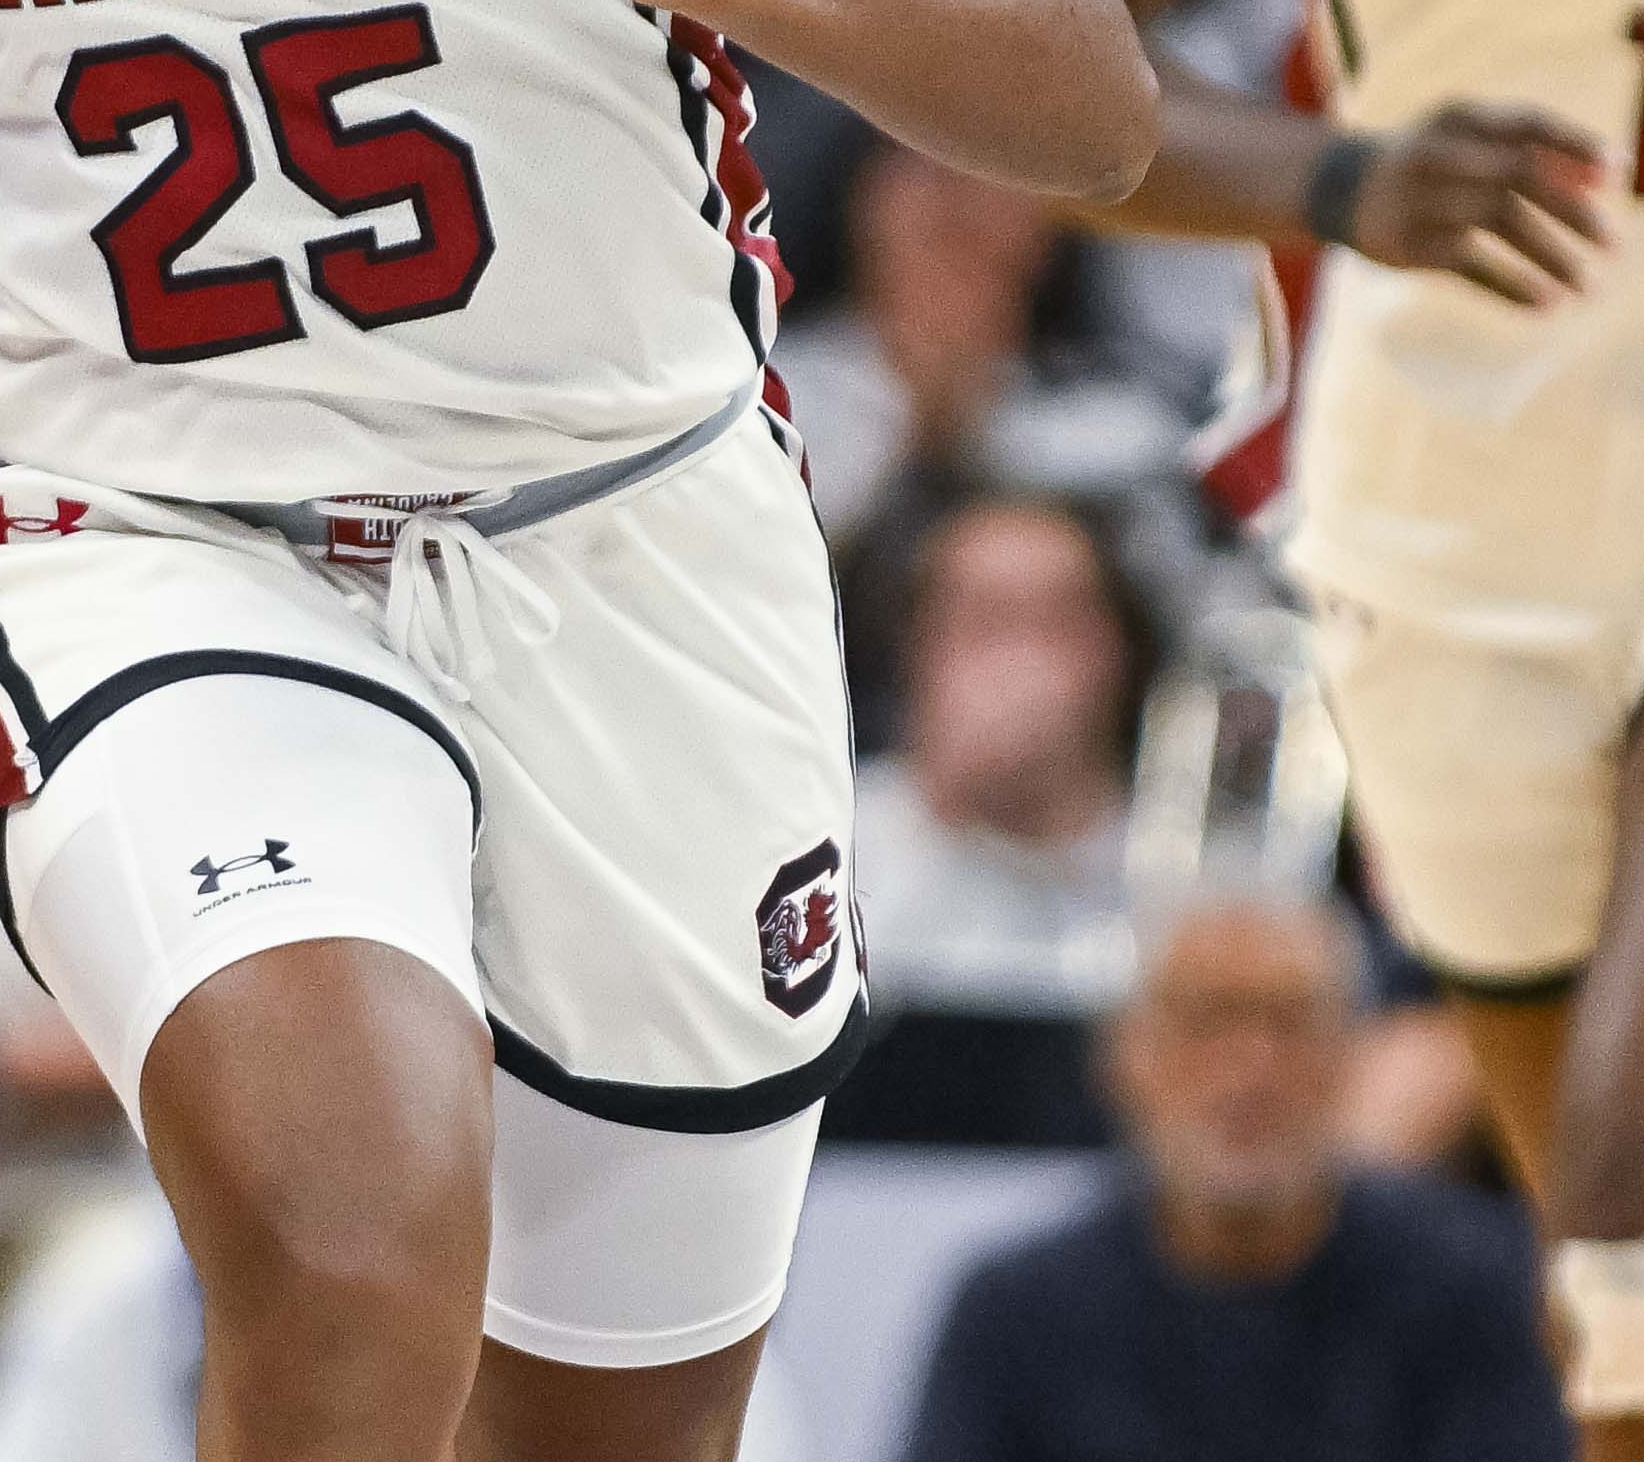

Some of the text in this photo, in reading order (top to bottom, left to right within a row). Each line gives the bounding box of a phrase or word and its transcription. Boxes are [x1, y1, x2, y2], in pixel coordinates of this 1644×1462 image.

[54, 2, 495, 363] 25
[192, 876, 312, 918] UNDER ARMOUR
